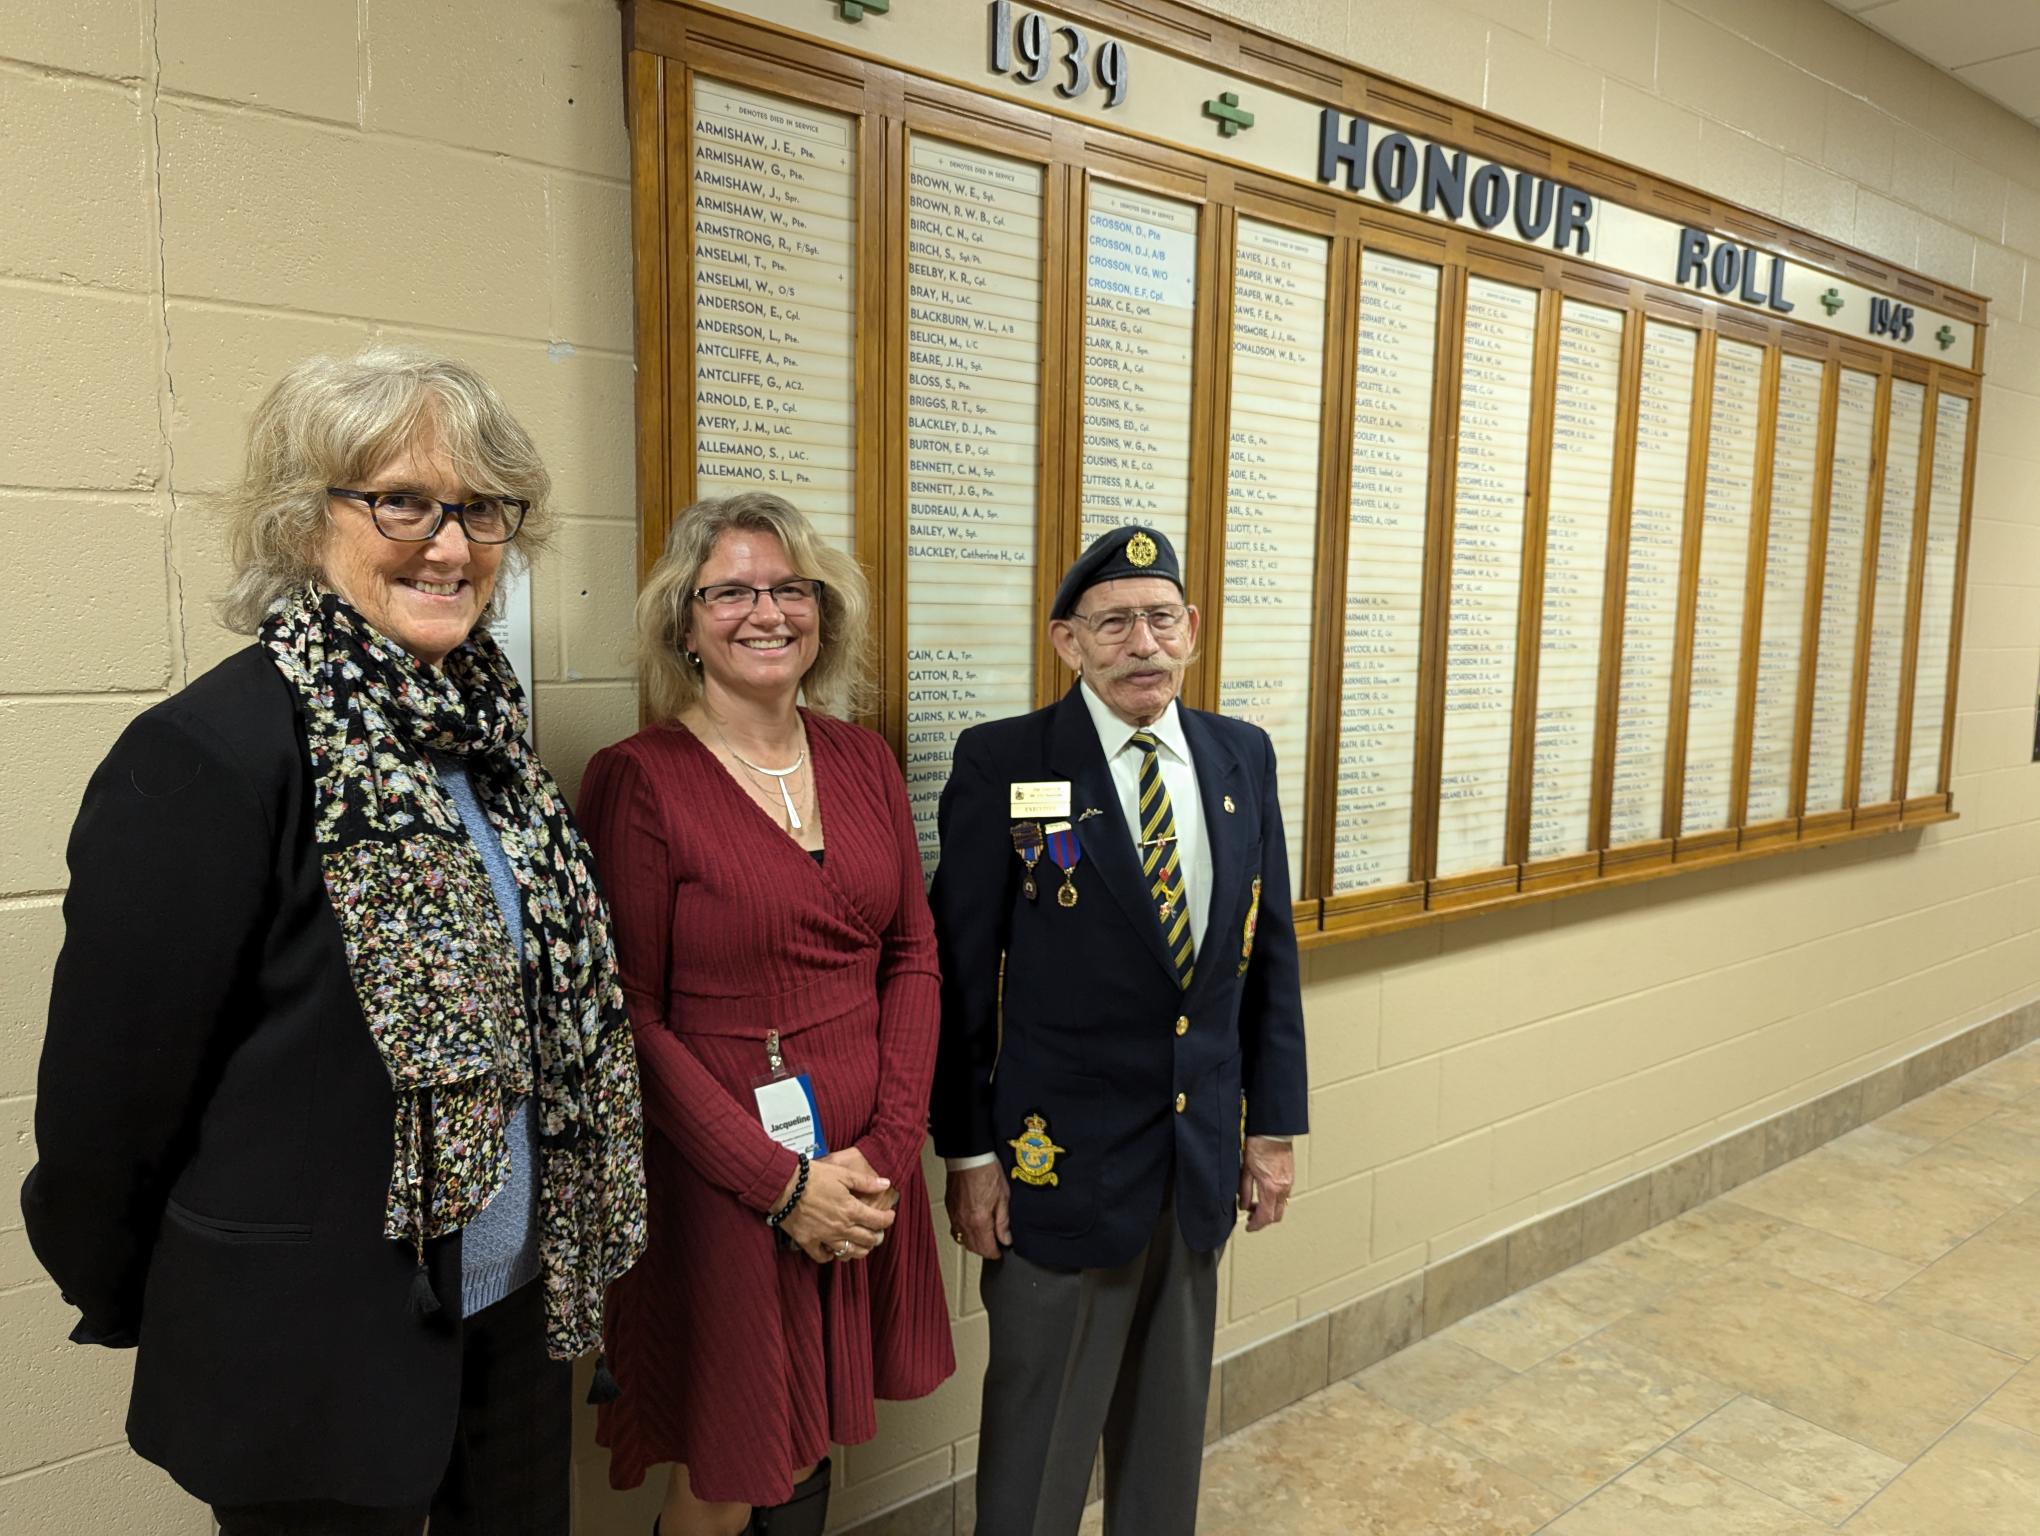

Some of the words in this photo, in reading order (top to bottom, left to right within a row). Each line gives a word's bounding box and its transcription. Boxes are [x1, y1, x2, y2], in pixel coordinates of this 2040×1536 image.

[991, 0, 1128, 110] 1939
[696, 120, 767, 150] ARMISHAW,
[771, 139, 780, 151] J.
[795, 121, 818, 133] SERVICE
[697, 147, 766, 174] ARMISHAW,
[695, 170, 765, 197] ARMISHAW,
[911, 173, 951, 194] BROWN,
[955, 184, 967, 196] W.
[696, 196, 766, 222] ARMISHAW,
[910, 196, 951, 216] BROWN,
[954, 205, 962, 217] R.
[965, 208, 977, 220] W.
[1318, 108, 1593, 256] HONOUR
[1676, 228, 1795, 313] ROLL
[911, 219, 942, 236] BIRCH,
[1090, 215, 1134, 235] CROSSON,
[696, 222, 774, 248] ARMSTRONG,
[910, 241, 943, 260] BIRCH,
[1089, 235, 1133, 255] CROSSON,
[696, 246, 750, 268] ANSELMI,
[1089, 255, 1132, 273] CROSSON,
[909, 263, 946, 281] BEELBY,
[697, 272, 751, 292] ANSELMI,
[1089, 277, 1132, 296] CROSSON,
[910, 285, 938, 301] BRAY,
[697, 295, 766, 317] ANDERSON,
[911, 308, 970, 329] BLACKBURN,
[974, 319, 986, 330] W.
[1869, 296, 1915, 343] 1945
[697, 319, 765, 341] ANDERSON,
[910, 330, 947, 348] BELICH,
[697, 343, 761, 364] ANTCLIFFE,
[910, 352, 943, 367] BEARE,
[698, 368, 763, 387] ANTCLIFFE,
[910, 374, 942, 389] BLOSS,
[697, 392, 750, 409] ARNOLD,
[754, 398, 763, 409] E.
[910, 395, 948, 412] BRIGGS,
[698, 416, 739, 432] AVERY,
[743, 420, 752, 431] J.
[909, 417, 959, 433] BLACKLEY,
[698, 441, 765, 459] ALLEMANO,
[909, 439, 952, 454] BURTON,
[698, 464, 765, 480] ALLEMANO,
[769, 469, 778, 480] S.
[910, 460, 955, 475] BENNETT,
[911, 482, 955, 496] BENNETT,
[911, 504, 959, 518] BUDREAU,
[910, 525, 945, 538] BAILEY,
[909, 546, 957, 559] BLACKLEY,
[908, 650, 933, 661] CAIN,
[908, 670, 949, 681] CATTON,
[909, 691, 949, 701] CATTON,
[908, 712, 945, 723] CAIRNS,
[908, 733, 946, 743] CARTER,
[770, 1115, 811, 1133] Jacqueline
